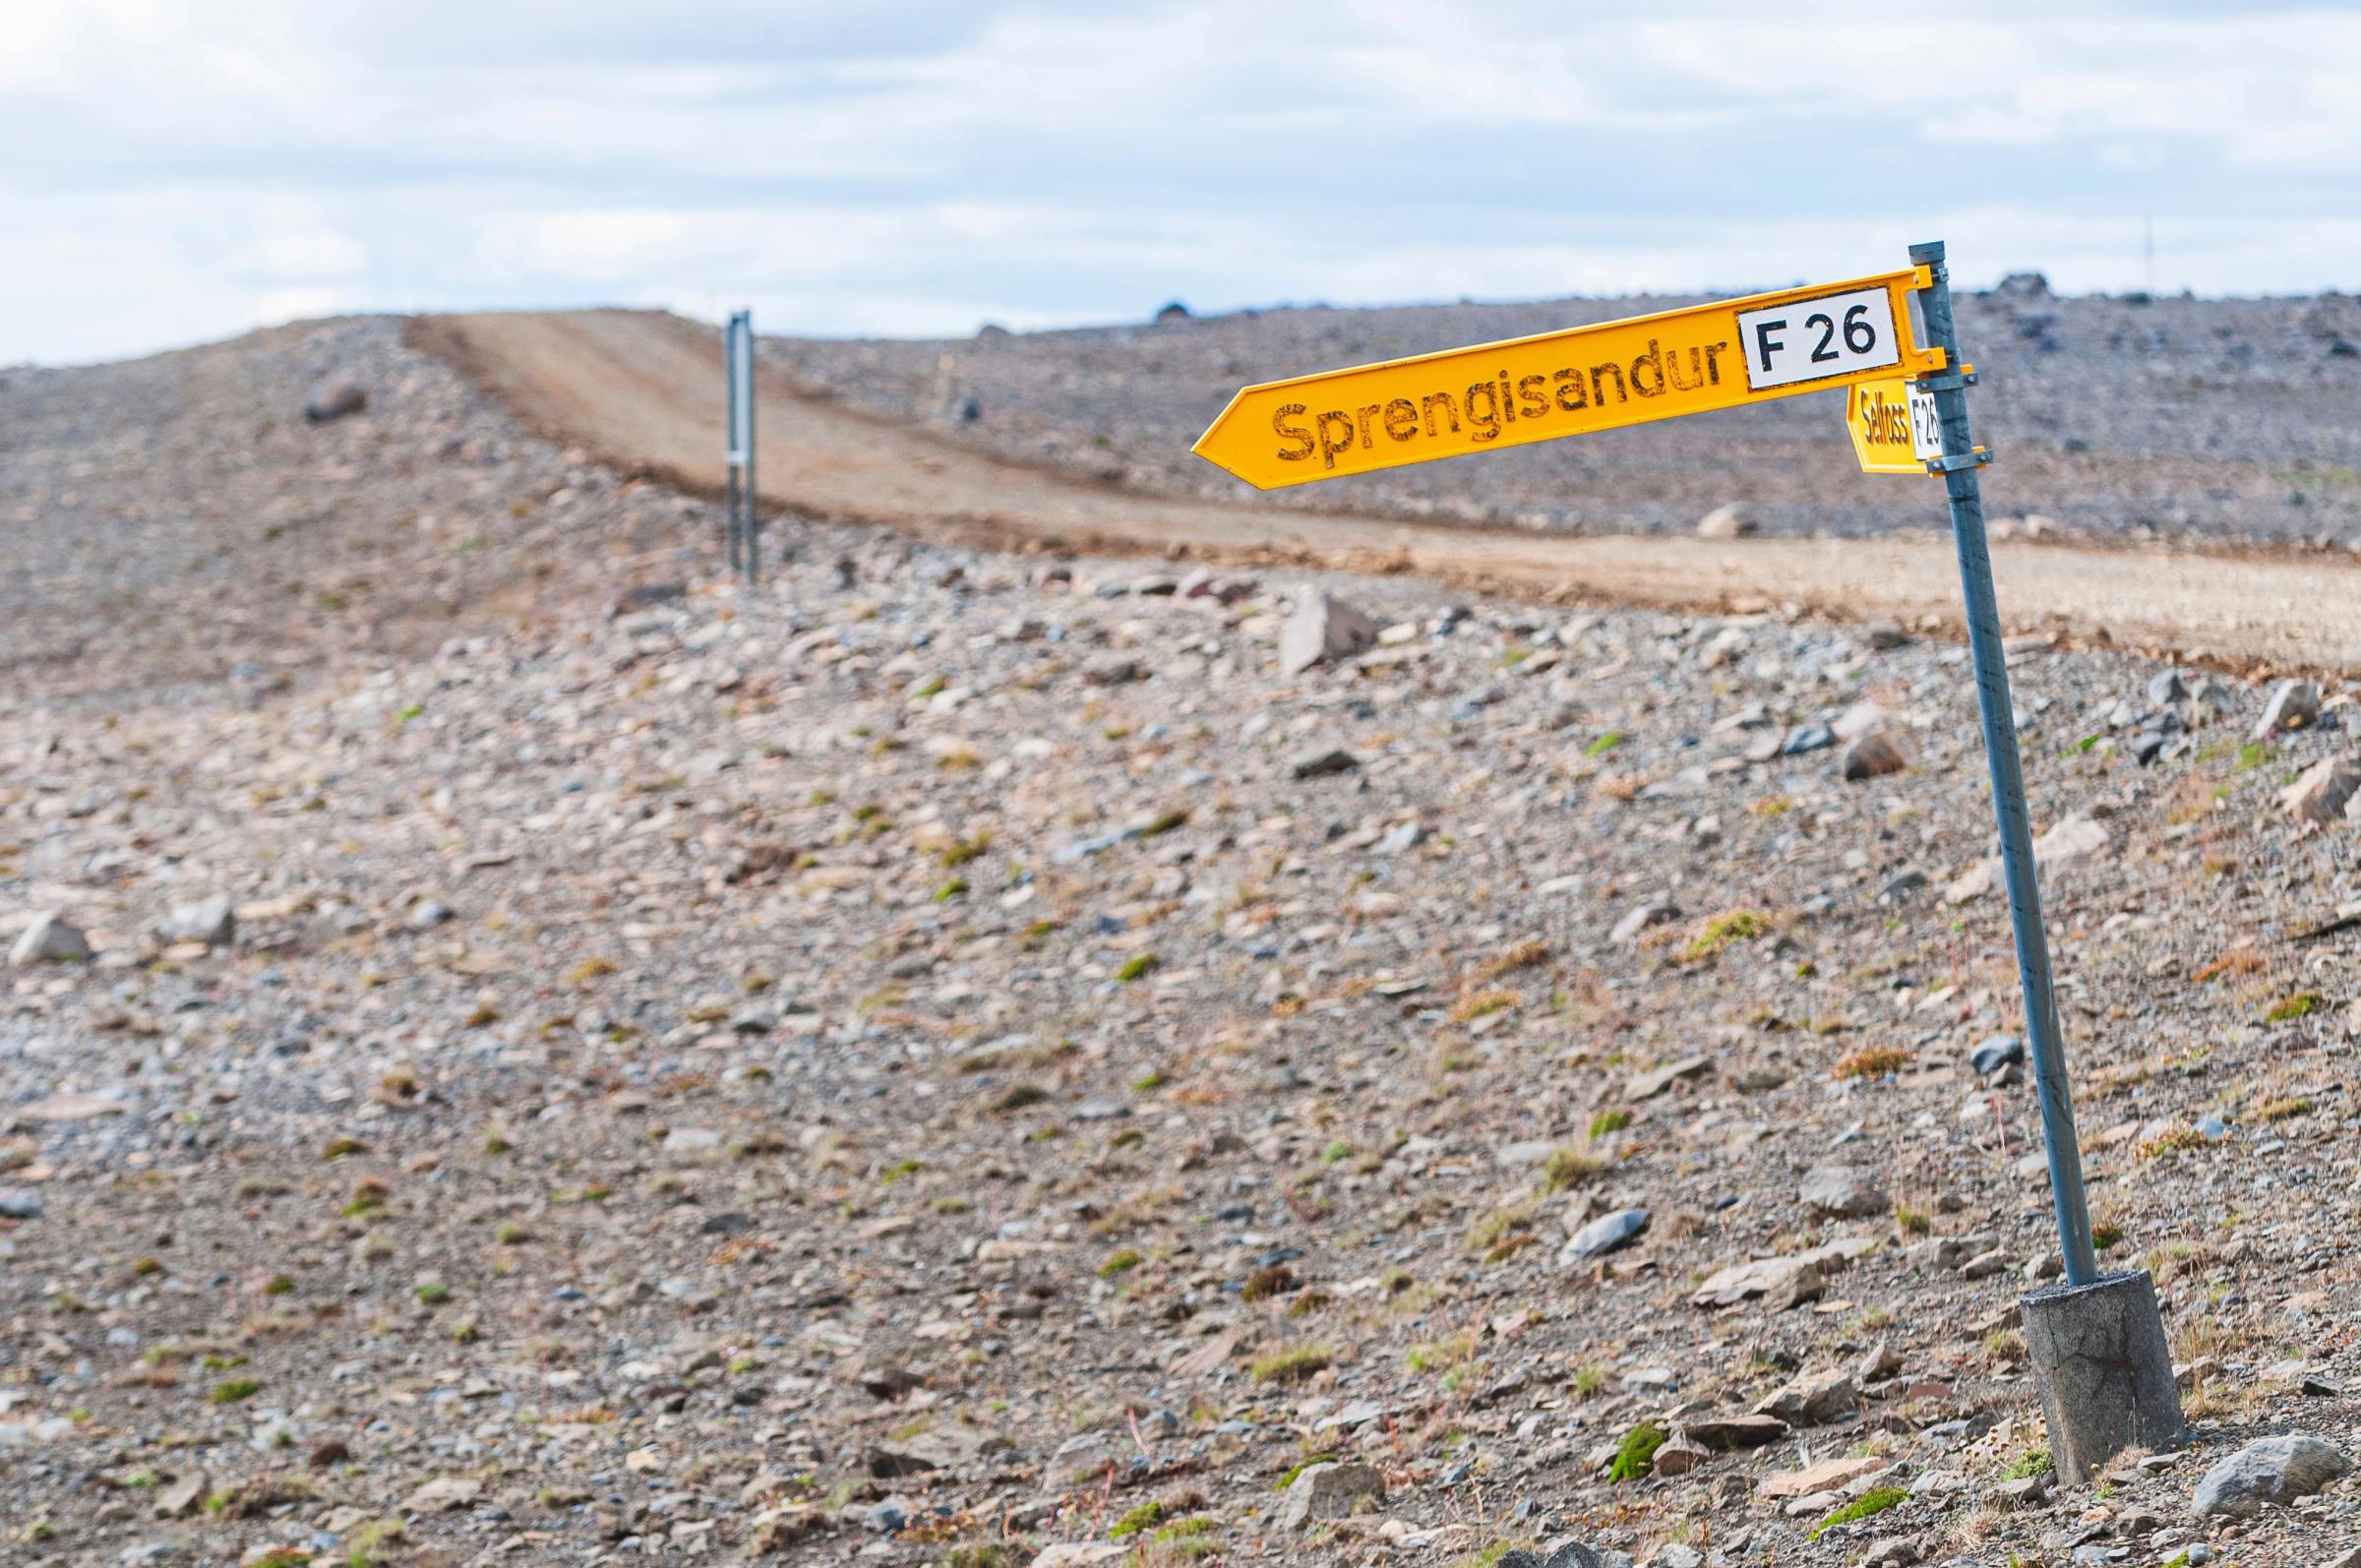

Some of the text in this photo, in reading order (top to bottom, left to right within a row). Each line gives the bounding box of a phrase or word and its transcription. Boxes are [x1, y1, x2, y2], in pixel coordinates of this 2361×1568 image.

[1756, 305, 1876, 372] F 26
[1273, 338, 1728, 469] Sprengisandur
[1860, 389, 1908, 446] Selfoss
